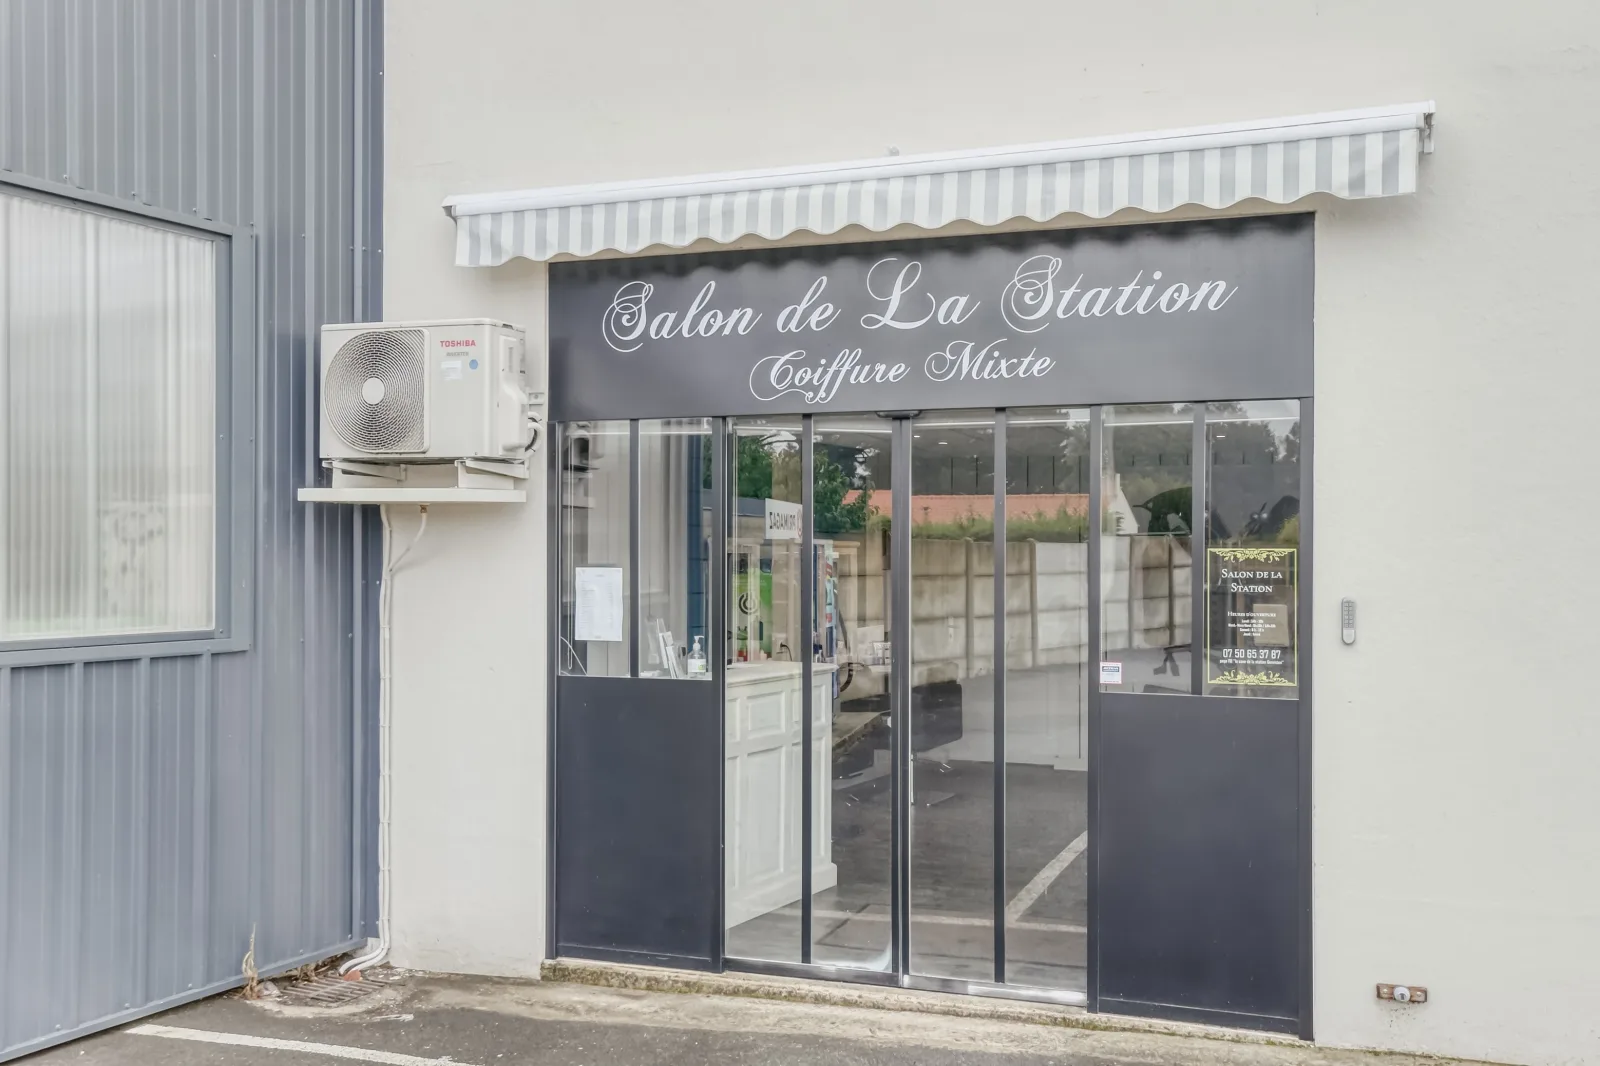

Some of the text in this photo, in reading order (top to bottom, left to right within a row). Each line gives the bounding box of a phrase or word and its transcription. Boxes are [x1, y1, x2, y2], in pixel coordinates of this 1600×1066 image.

[603, 254, 1238, 352] Salon de La Station
[440, 339, 476, 347] TOSHIBA
[750, 338, 1057, 404] Coiffure Mixte
[1222, 648, 1233, 658] 07
[1234, 648, 1245, 659] 50
[1246, 649, 1257, 659] 65
[1259, 649, 1270, 659] 37
